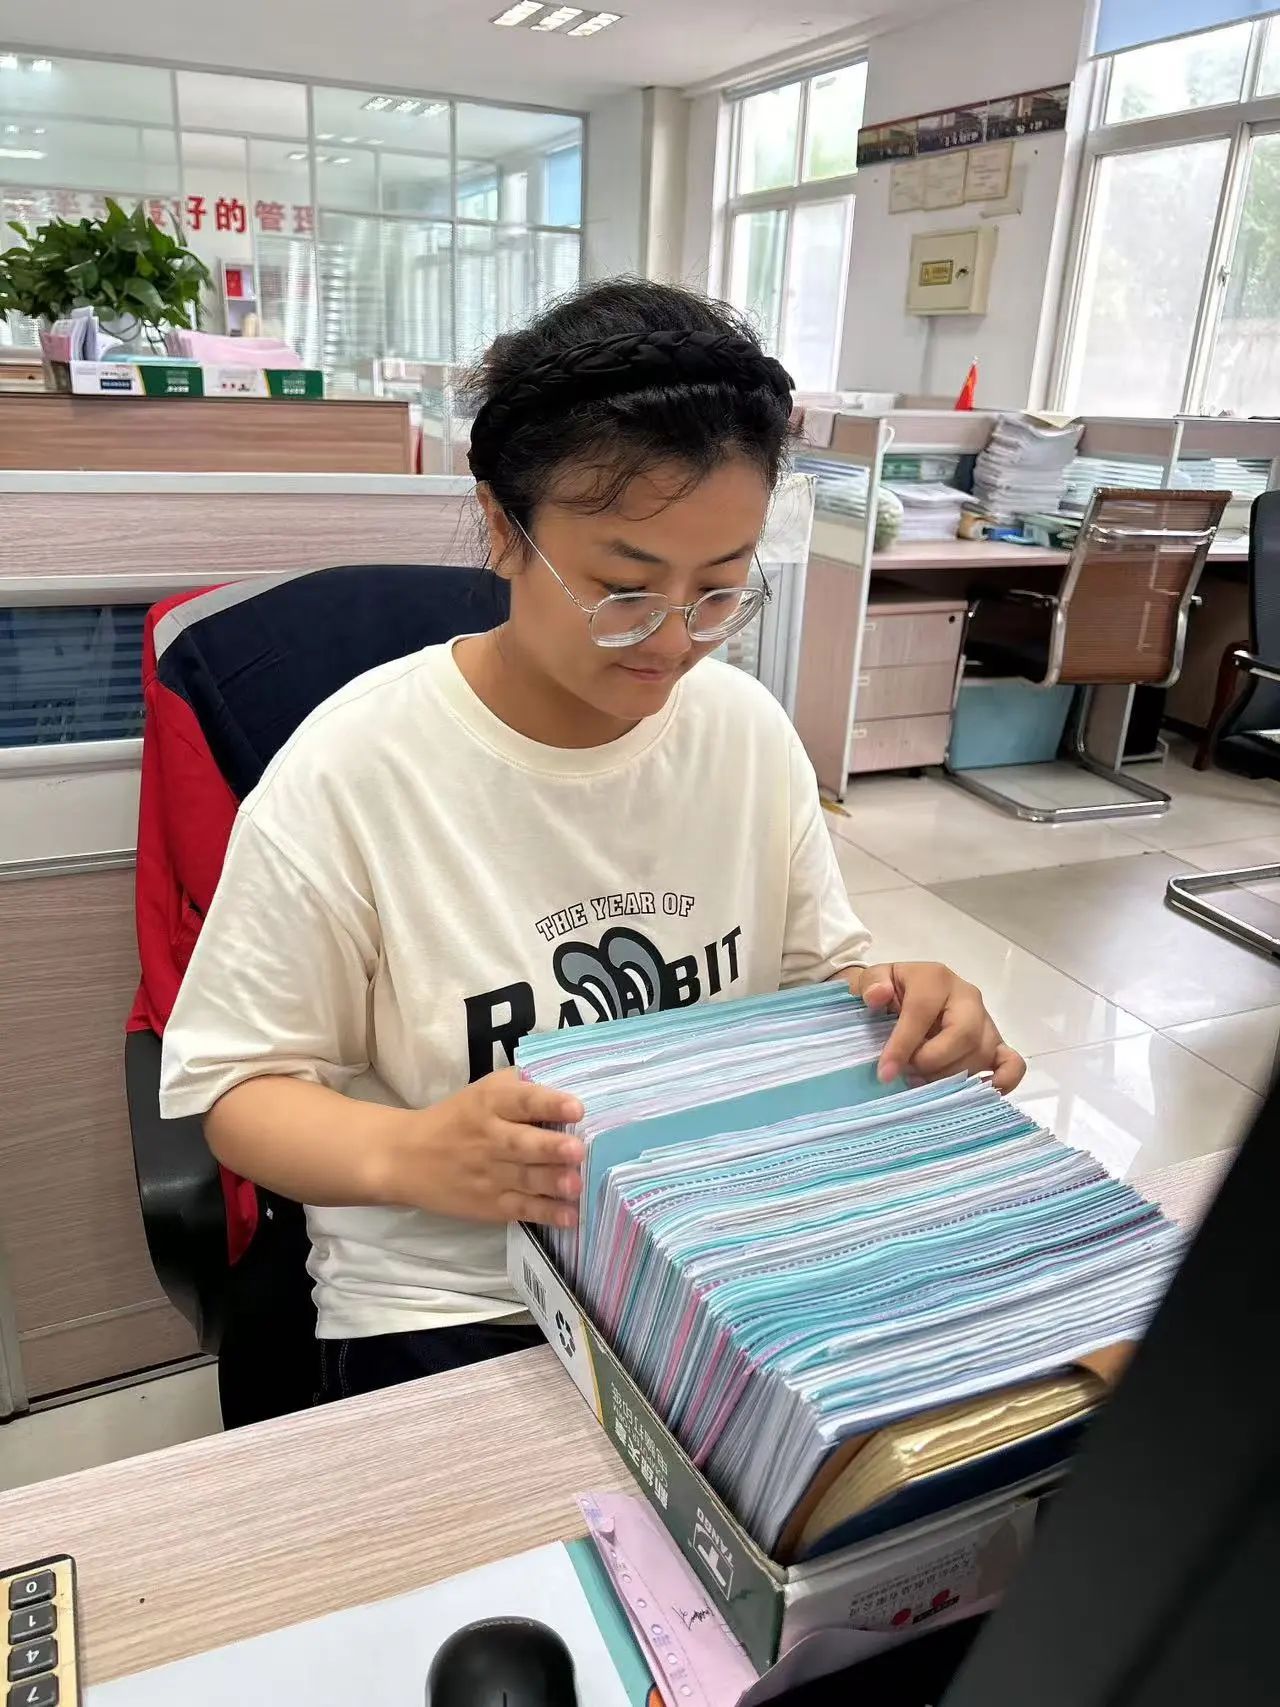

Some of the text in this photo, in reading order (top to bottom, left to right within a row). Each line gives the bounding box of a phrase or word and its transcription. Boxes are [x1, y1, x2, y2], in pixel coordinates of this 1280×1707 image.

[535, 892, 695, 942] THE YEAR OF
[697, 1507, 736, 1568] TANGO
[26, 1581, 37, 1593] 0
[29, 1615, 37, 1627] 1
[25, 1649, 40, 1663] 4
[26, 1686, 40, 1703] 7
